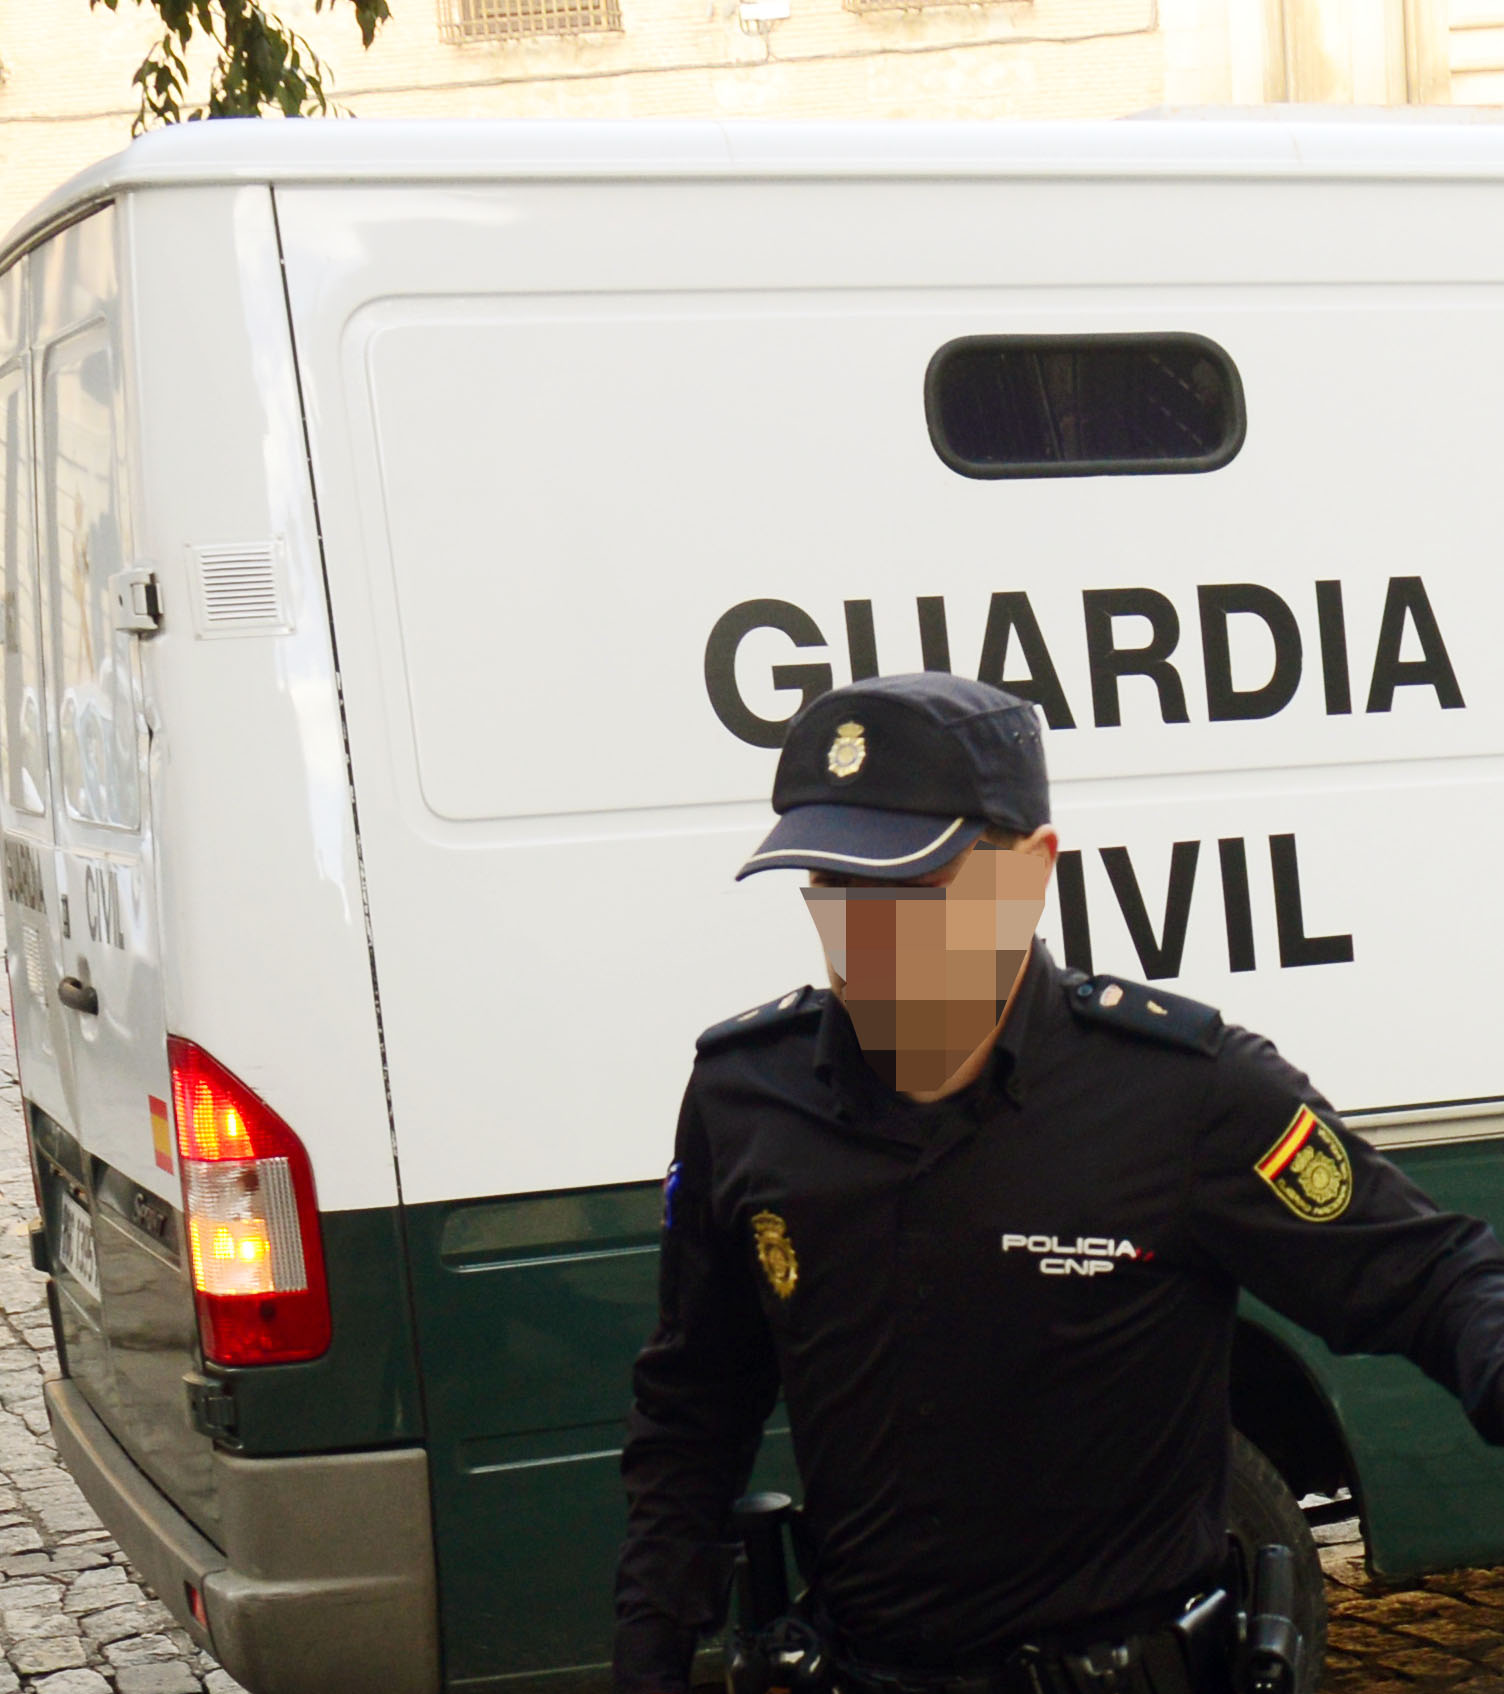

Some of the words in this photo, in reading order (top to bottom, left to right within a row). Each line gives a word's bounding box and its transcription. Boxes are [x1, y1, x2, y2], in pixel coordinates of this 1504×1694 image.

[1054, 833, 1355, 981] IVIL
[1001, 1233, 1137, 1259] POLICIA
[1039, 1257, 1115, 1277] CNP
